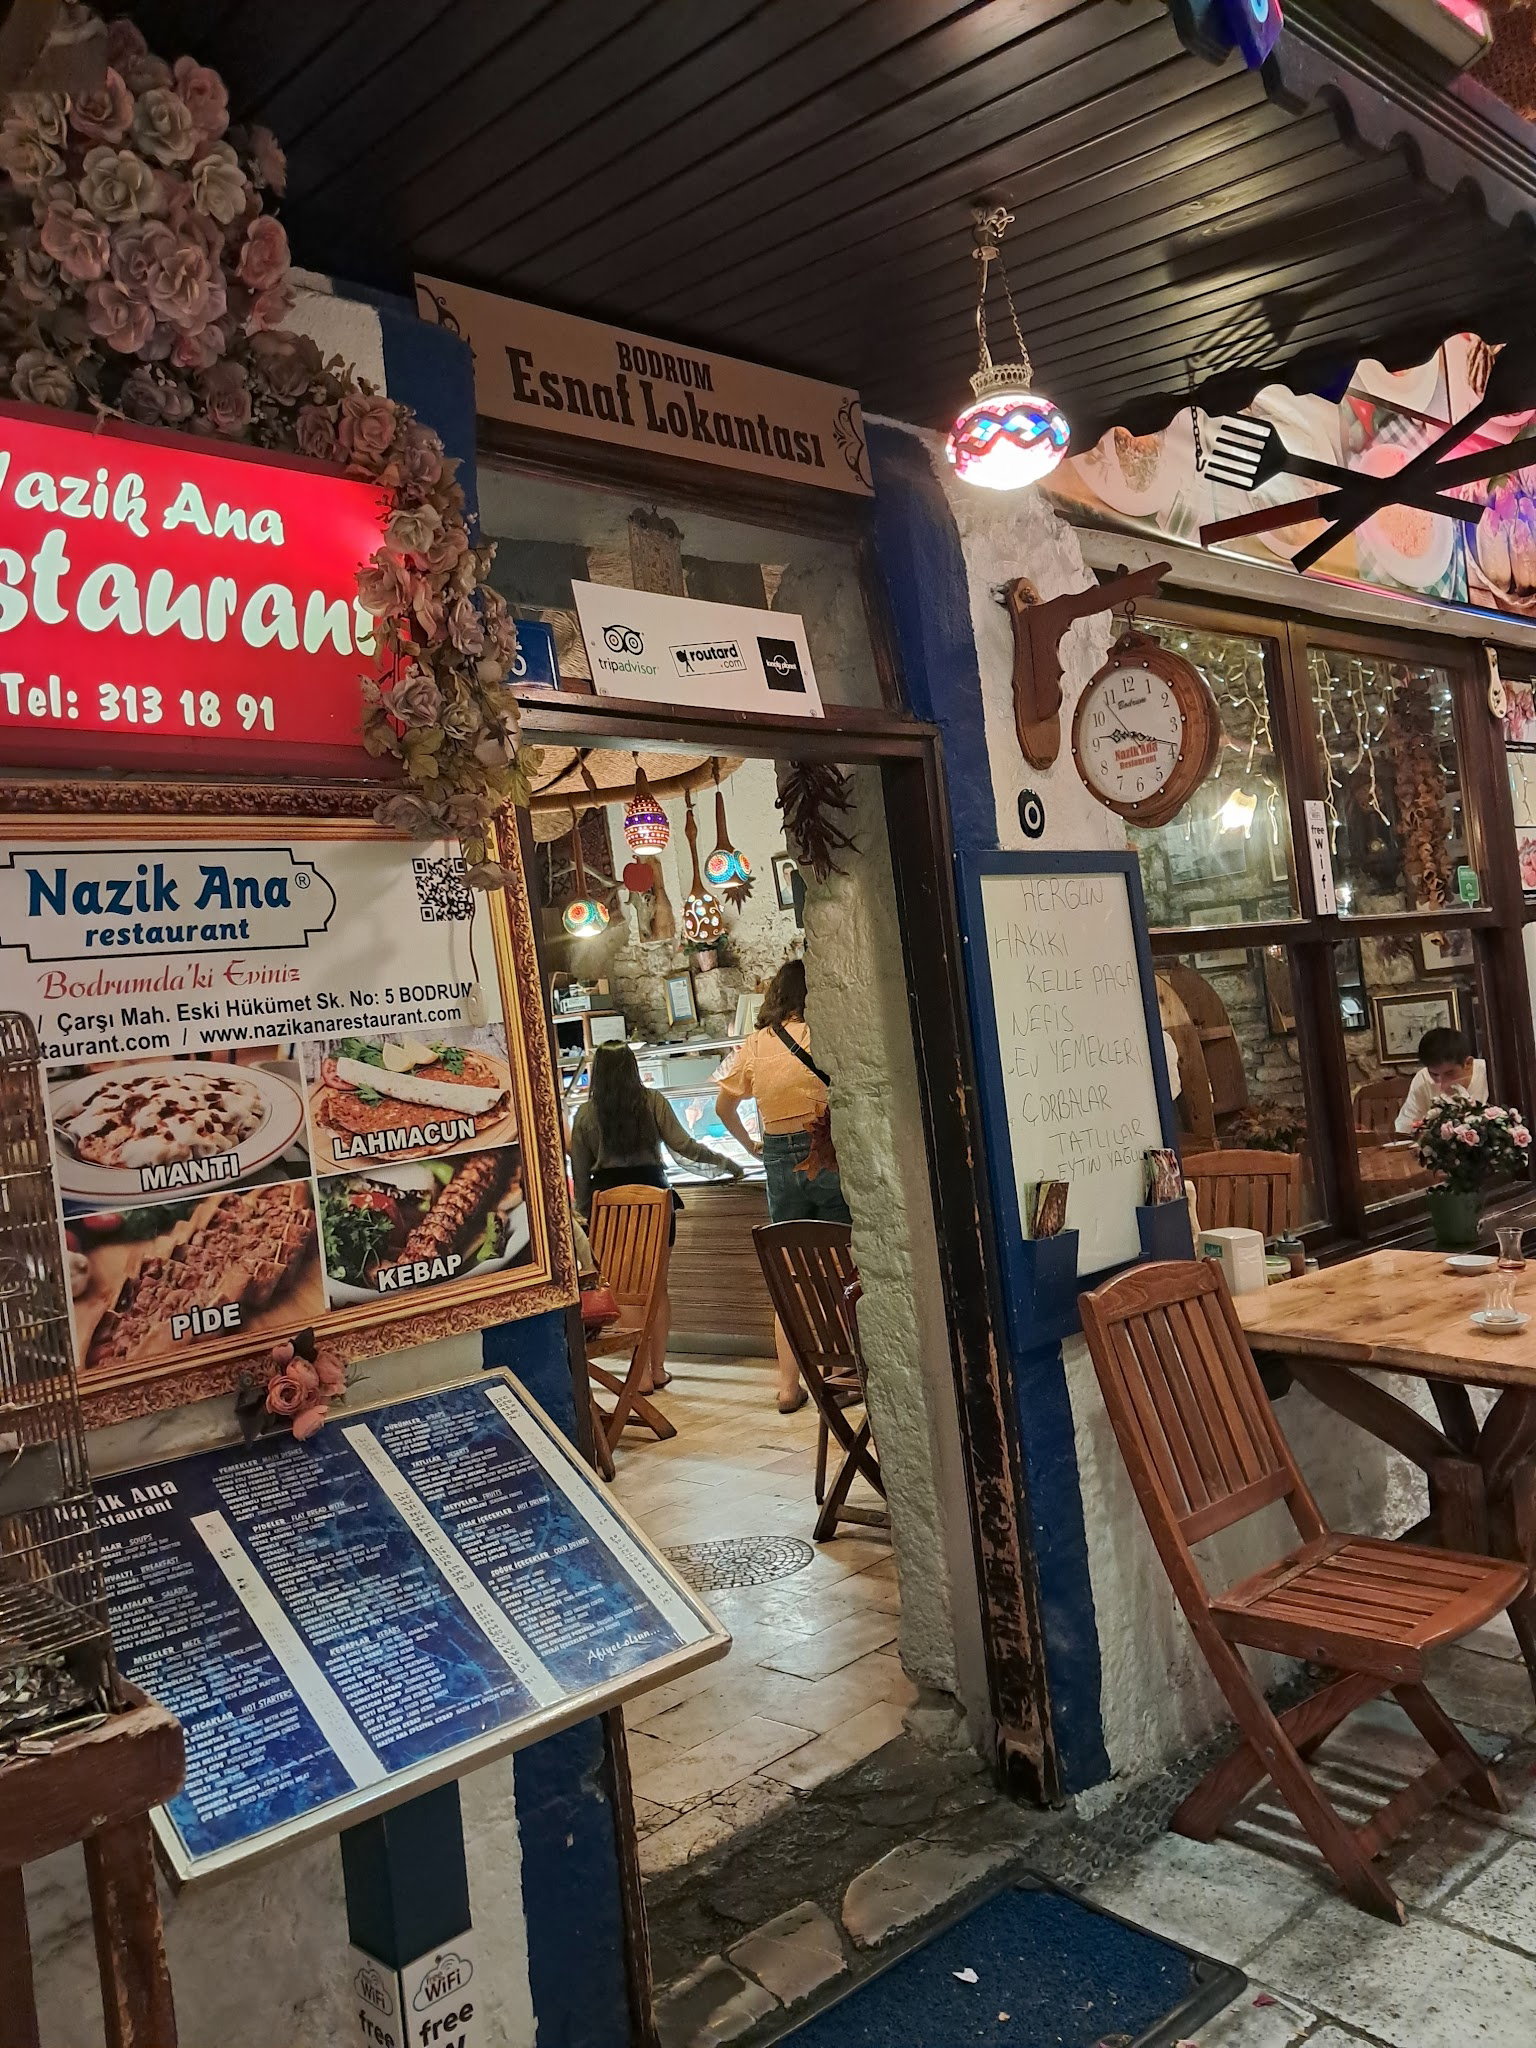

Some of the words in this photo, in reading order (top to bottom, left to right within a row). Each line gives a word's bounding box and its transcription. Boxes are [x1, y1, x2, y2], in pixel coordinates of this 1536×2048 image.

[616, 342, 714, 392] BODRUM
[505, 346, 634, 426] Esnaf
[639, 380, 826, 468] Lokantası
[0, 451, 150, 538] azik
[163, 482, 286, 546] Ana
[0, 528, 377, 656] staurant
[599, 657, 657, 676] tripadvisor
[690, 644, 738, 661] routard
[1122, 676, 1135, 693] 12
[1146, 679, 1151, 694] 1
[0, 673, 79, 720] Tel:
[99, 683, 163, 724] 313
[181, 689, 221, 728] 18
[237, 694, 276, 732] 91
[1161, 692, 1170, 708] 2
[1093, 711, 1106, 728] 10
[1170, 717, 1178, 733] 3
[1092, 738, 1101, 752] 9
[1101, 760, 1109, 775] 8
[1119, 755, 1157, 770] Restaurant
[1156, 767, 1163, 781] 5
[1117, 775, 1124, 790] 7
[1136, 777, 1144, 793] 6
[1311, 825, 1325, 834] free
[26, 864, 179, 918] Nazik
[193, 865, 291, 910] Ana
[85, 918, 250, 948] restaurant
[37, 960, 215, 1000] Bodrumda'ki
[223, 959, 302, 987] Eviniz
[1026, 964, 1083, 993] KELLE
[56, 1012, 115, 1037] Çarşı
[121, 1006, 172, 1028] Mah.
[177, 1000, 221, 1022] Eski
[227, 993, 312, 1019] Hükümet
[317, 991, 346, 1011] Sk.
[350, 989, 380, 1008] No:
[385, 988, 396, 1004] 5
[400, 982, 472, 1003] BODRUM
[199, 1007, 462, 1045] www.nazikanarestaurant.com
[1022, 1085, 1112, 1126] ÇORBALAR
[332, 1117, 476, 1161] LAHMACUN
[1049, 1118, 1145, 1155] TATLILAR
[140, 1153, 240, 1192] MANTI
[377, 1253, 463, 1293] KEBAP
[171, 1301, 242, 1340] PİDE
[128, 1479, 178, 1503] Ana
[442, 1496, 477, 1512] MEYVELER
[253, 1517, 285, 1533] PİDELER
[291, 1512, 305, 1520] FLAT
[306, 1506, 326, 1516] BREAD
[328, 1500, 345, 1510] WITH
[516, 1502, 528, 1510] HOT
[553, 1545, 568, 1554] COLD
[568, 1537, 589, 1548] DRINKS
[133, 1645, 174, 1665] MEZELER
[587, 1641, 624, 1664] Afiyet
[241, 1702, 256, 1713] HOT
[258, 1689, 292, 1707] STARTERS
[360, 1976, 385, 2009] WiFi
[425, 1969, 462, 2002] WiFi
[358, 2010, 395, 2047] free
[419, 2002, 474, 2047] free
